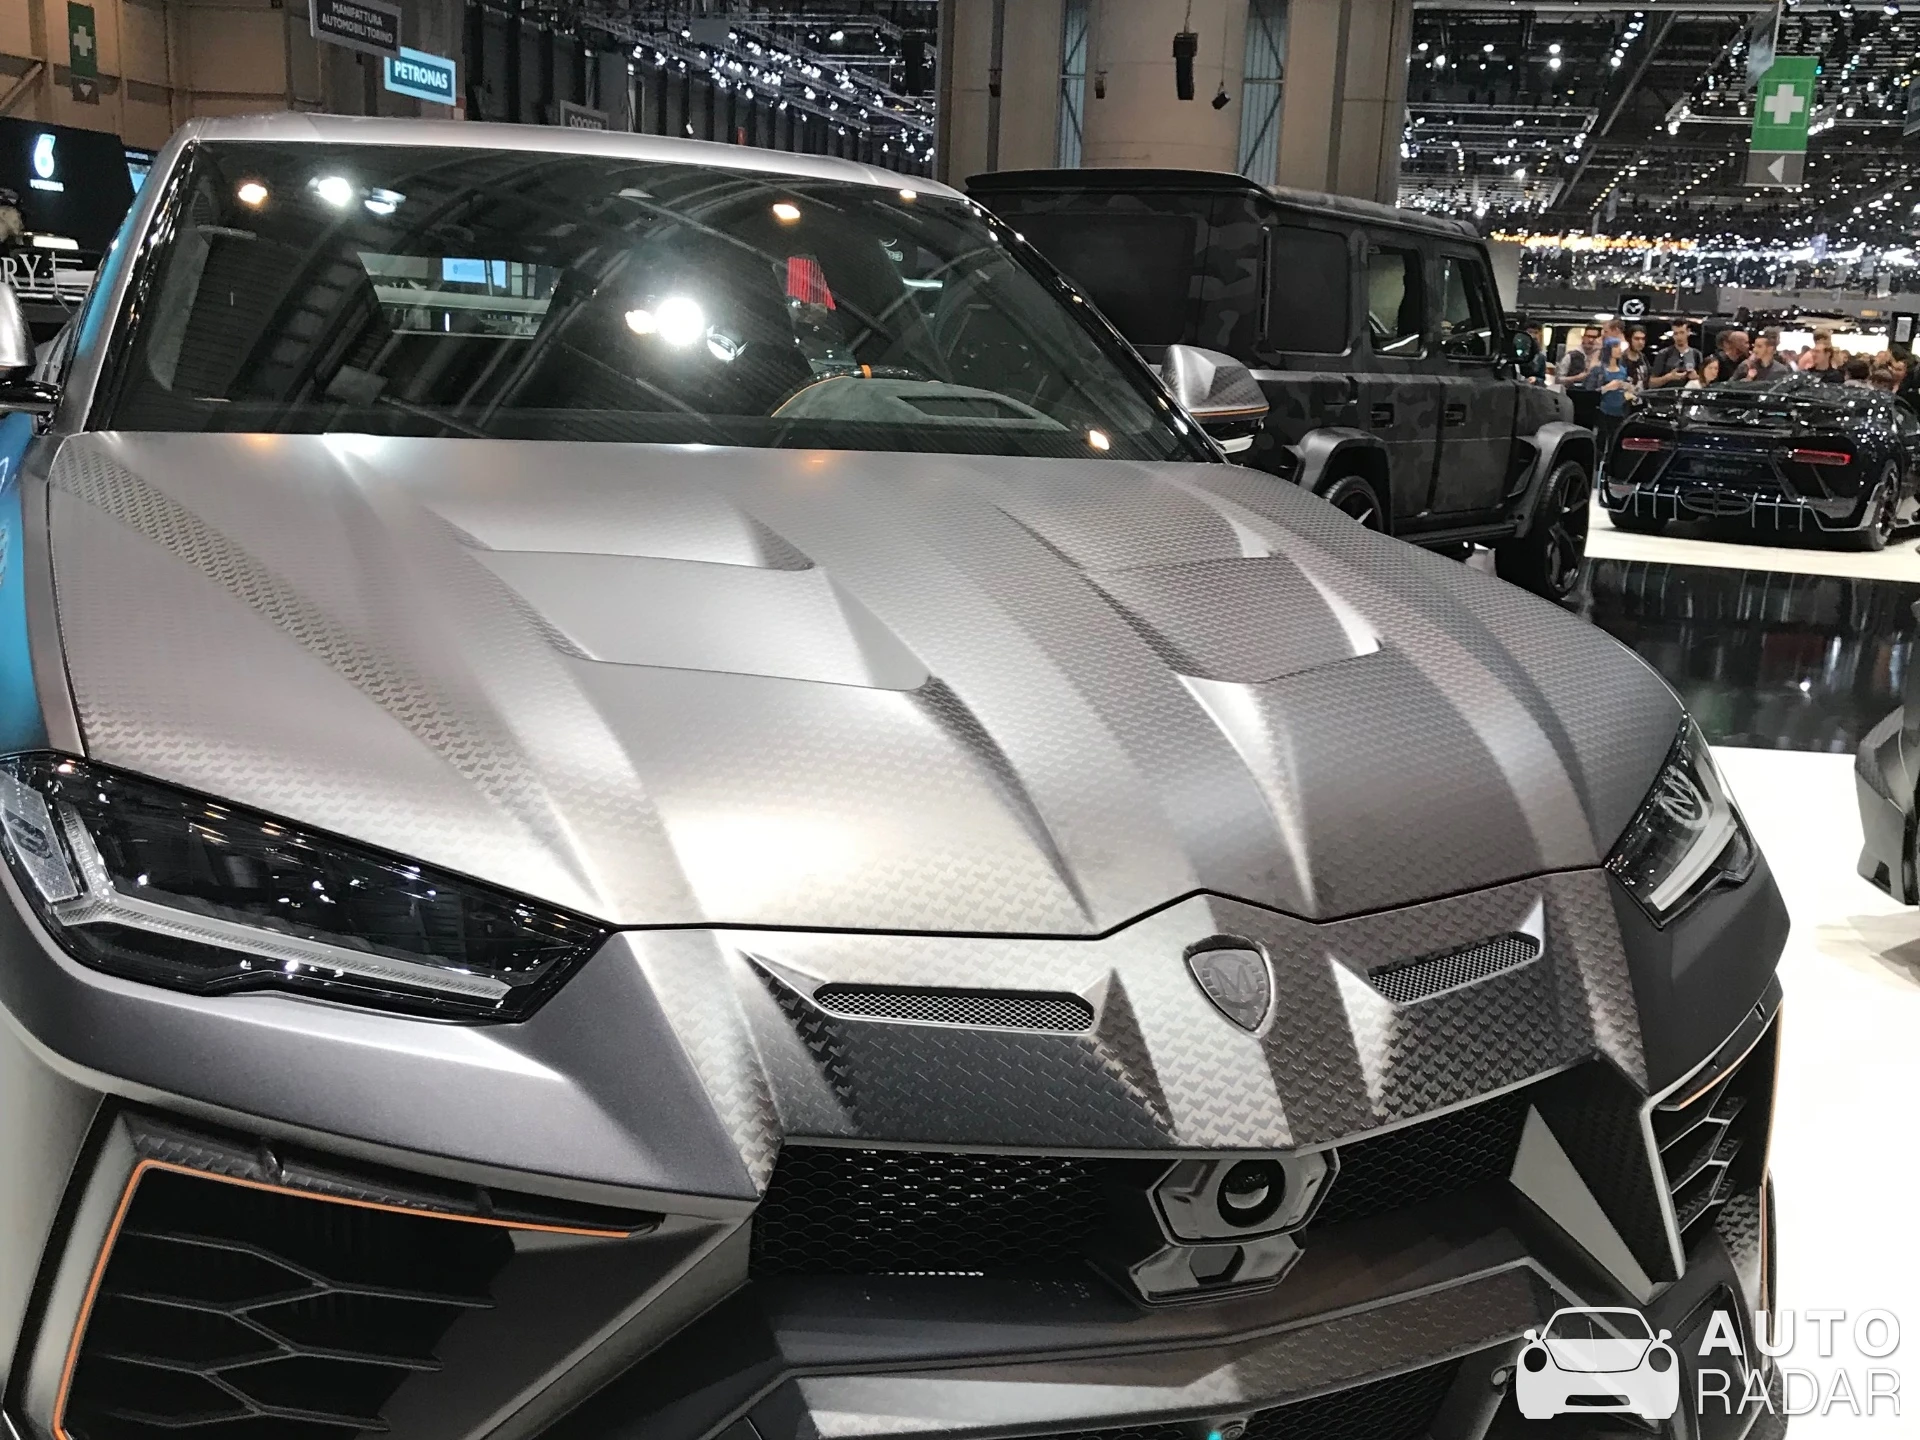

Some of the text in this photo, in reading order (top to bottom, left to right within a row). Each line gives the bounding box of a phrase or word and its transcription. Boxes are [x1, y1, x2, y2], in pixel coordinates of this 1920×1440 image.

[332, 2, 383, 27] MANIFATTURA
[394, 60, 448, 90] PETRONAS
[0, 254, 42, 289] RY
